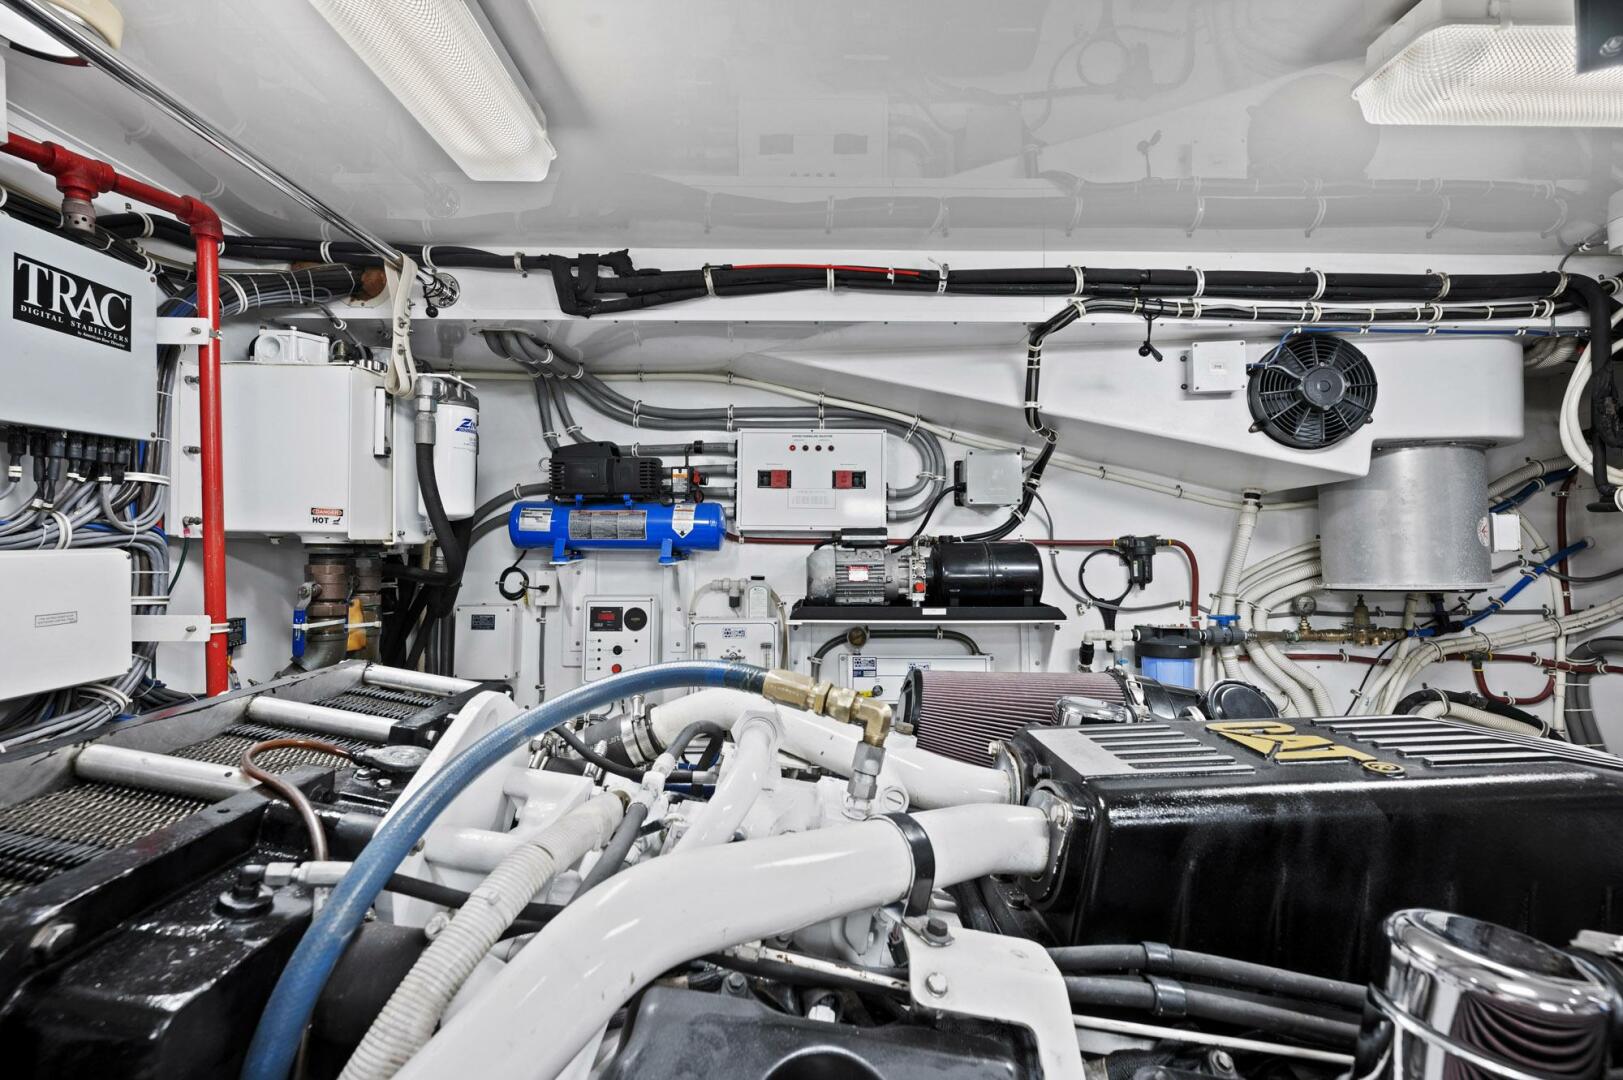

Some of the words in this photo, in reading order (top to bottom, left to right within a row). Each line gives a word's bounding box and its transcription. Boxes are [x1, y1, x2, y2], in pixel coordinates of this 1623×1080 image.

[17, 258, 127, 331] TRAC
[20, 304, 64, 323] DIGITAL
[70, 320, 129, 343] STABILIZERS
